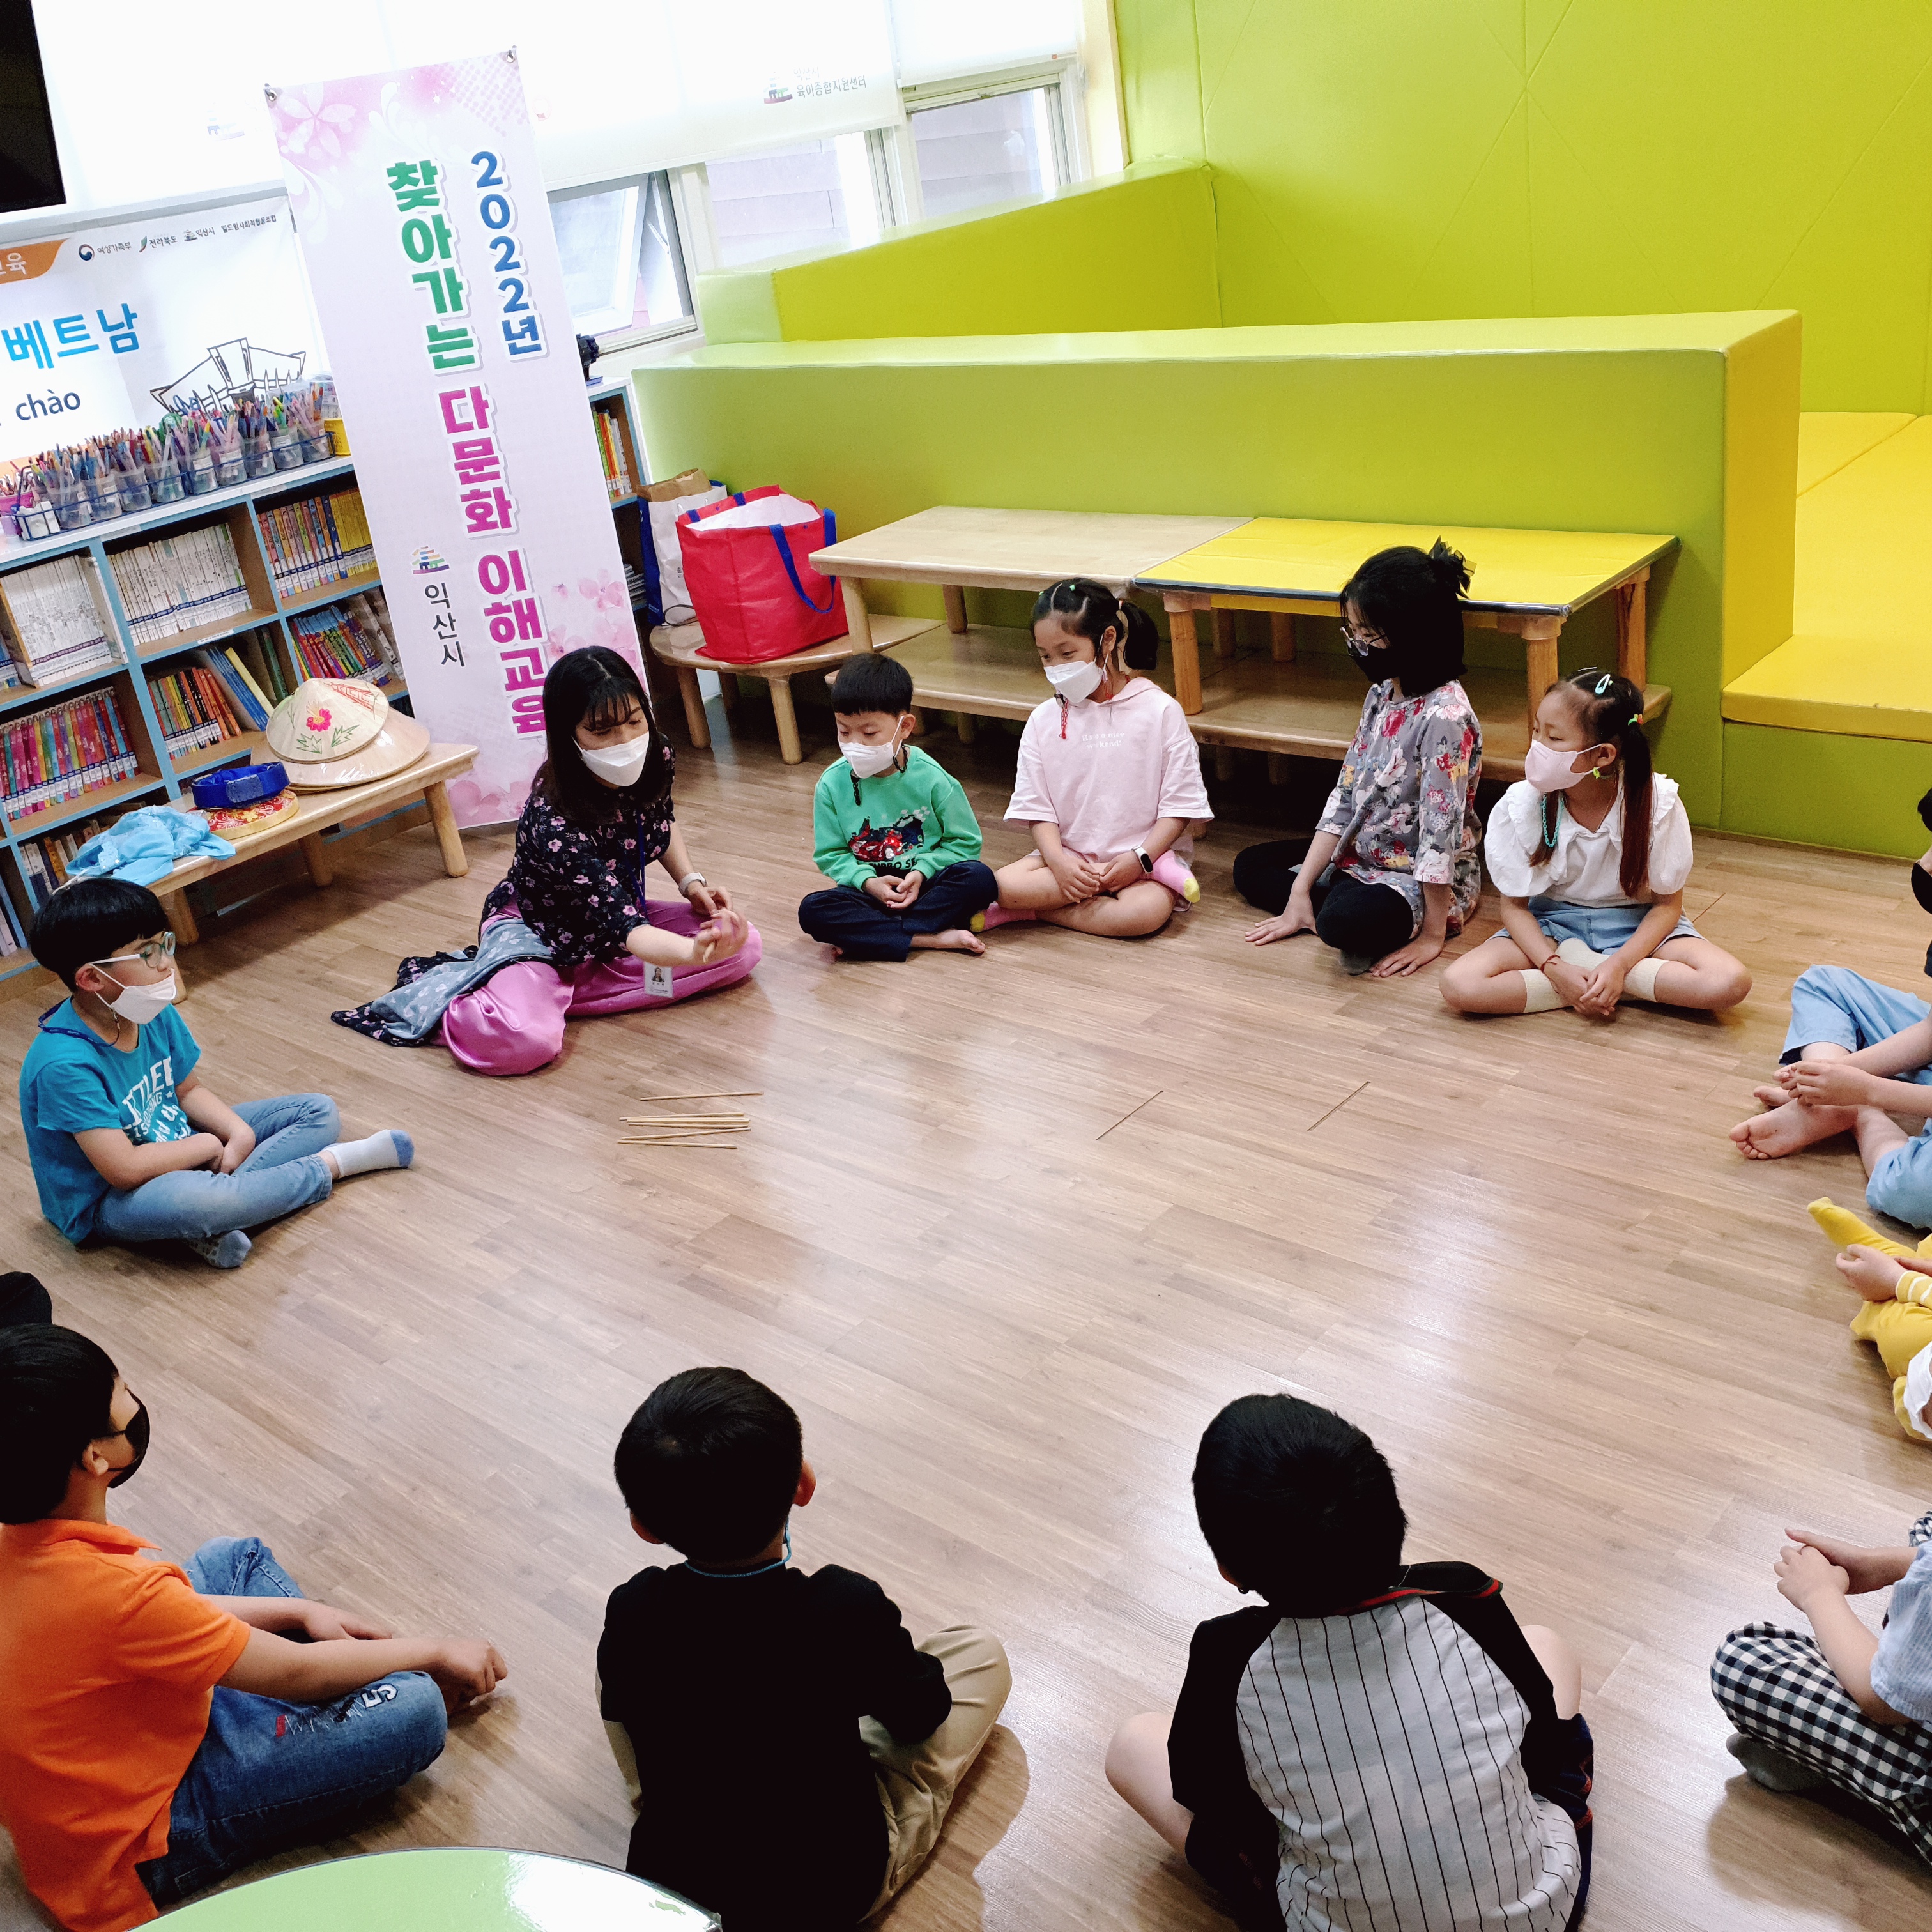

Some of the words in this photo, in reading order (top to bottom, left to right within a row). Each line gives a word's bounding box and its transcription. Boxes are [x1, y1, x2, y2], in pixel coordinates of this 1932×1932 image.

[797, 75, 866, 98] 육아종합지원센터
[0, 252, 27, 275] 육
[97, 241, 132, 254] 여성가족부
[149, 236, 178, 249] 전라북도
[195, 226, 215, 237] 익산시
[471, 151, 542, 356] 2022년
[0, 303, 140, 369] 베트남
[386, 159, 476, 371] 찾아가는
[438, 385, 513, 534] 다문화
[15, 388, 81, 421] chào
[424, 582, 466, 668] 익산시
